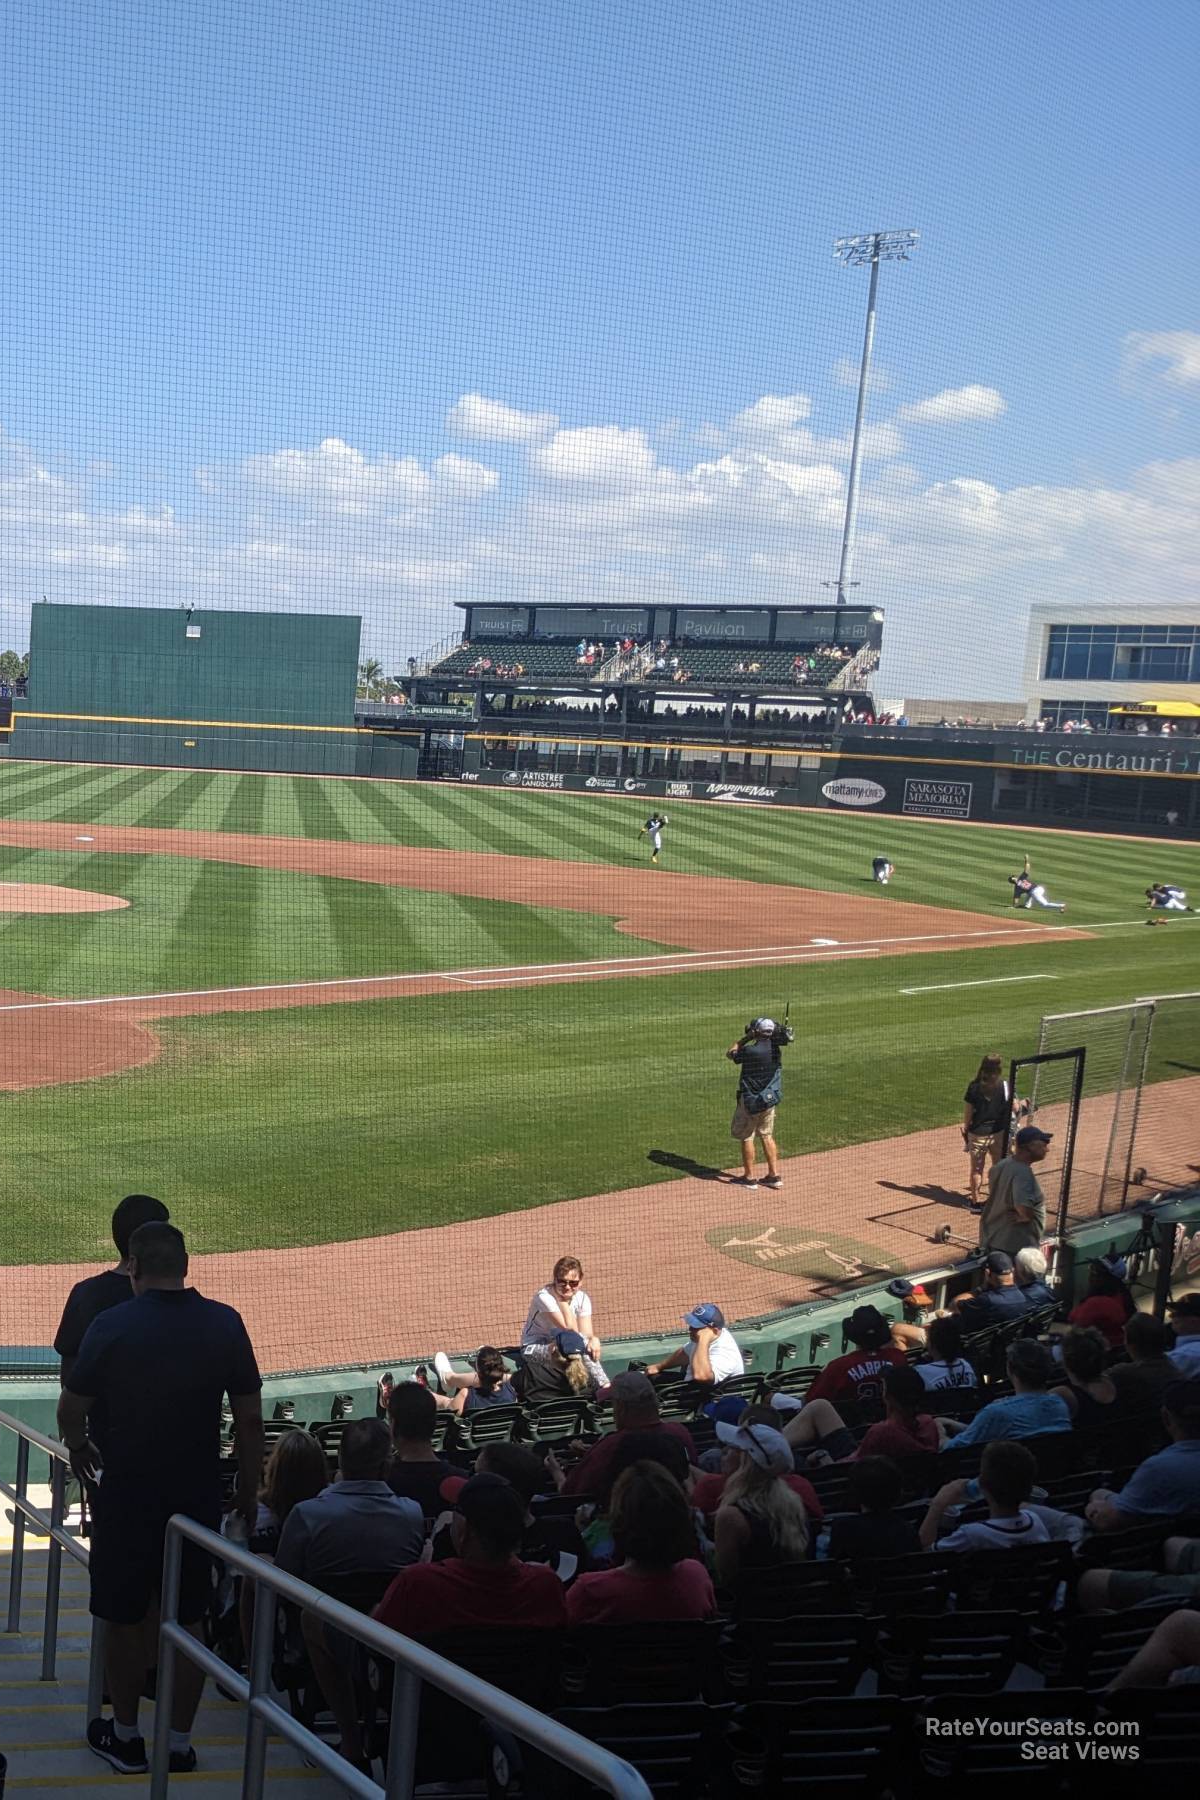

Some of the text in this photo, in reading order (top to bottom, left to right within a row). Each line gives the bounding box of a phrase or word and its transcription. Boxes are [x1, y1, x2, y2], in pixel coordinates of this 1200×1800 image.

[480, 620, 510, 630] TRUIST
[602, 619, 644, 634] Truist
[685, 620, 745, 636] Pavilion
[1012, 750, 1050, 766] THE
[1055, 750, 1173, 774] Centauri
[522, 772, 564, 782] ARTISTREE
[522, 780, 564, 789] LANDSCAPE
[910, 782, 966, 796] SARASOTA
[908, 792, 966, 806] MEMORIAL
